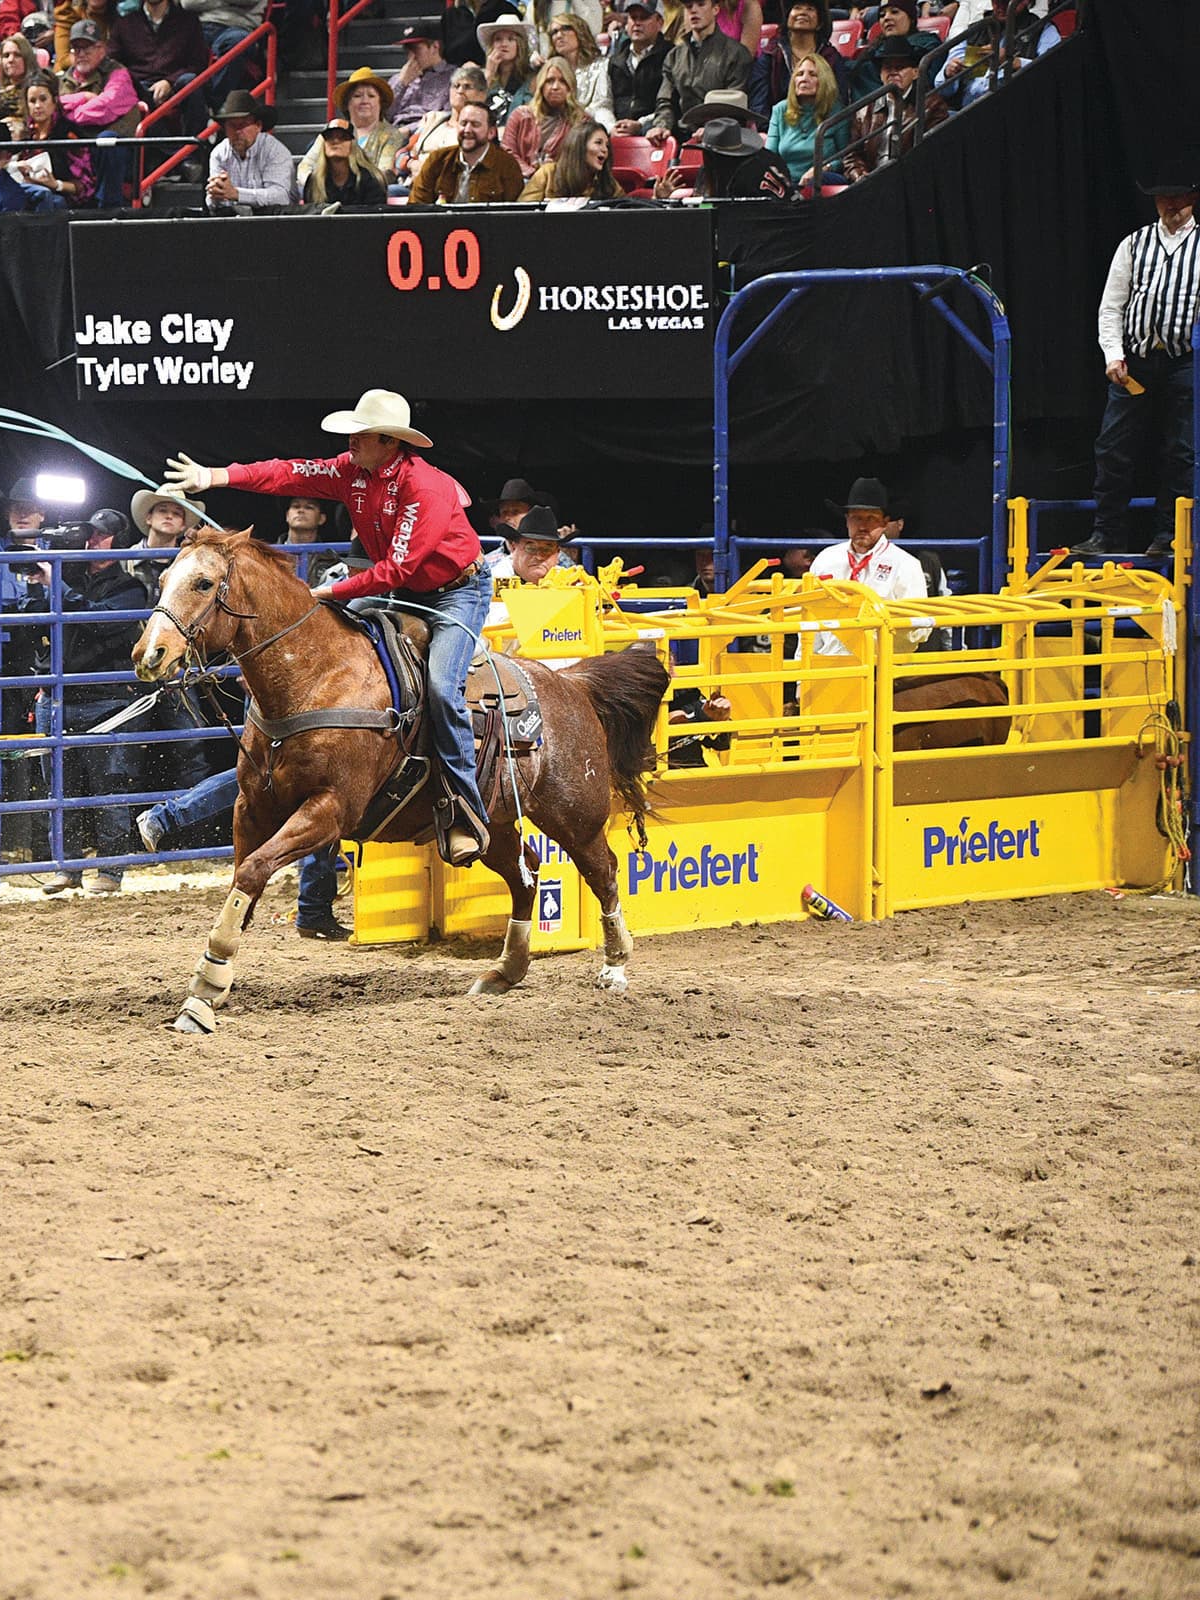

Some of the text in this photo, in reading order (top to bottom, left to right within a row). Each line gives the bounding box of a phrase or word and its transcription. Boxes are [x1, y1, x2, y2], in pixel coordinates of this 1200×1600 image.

[386, 228, 482, 291] 0.0
[74, 312, 234, 352] Jake Clay
[607, 315, 705, 330] LAS VEGAS
[76, 355, 255, 392] Tyler Worley
[391, 501, 421, 566] Wrangle
[542, 627, 583, 643] Priefert
[923, 817, 1040, 868] Priefert
[627, 840, 760, 896] Priefert
